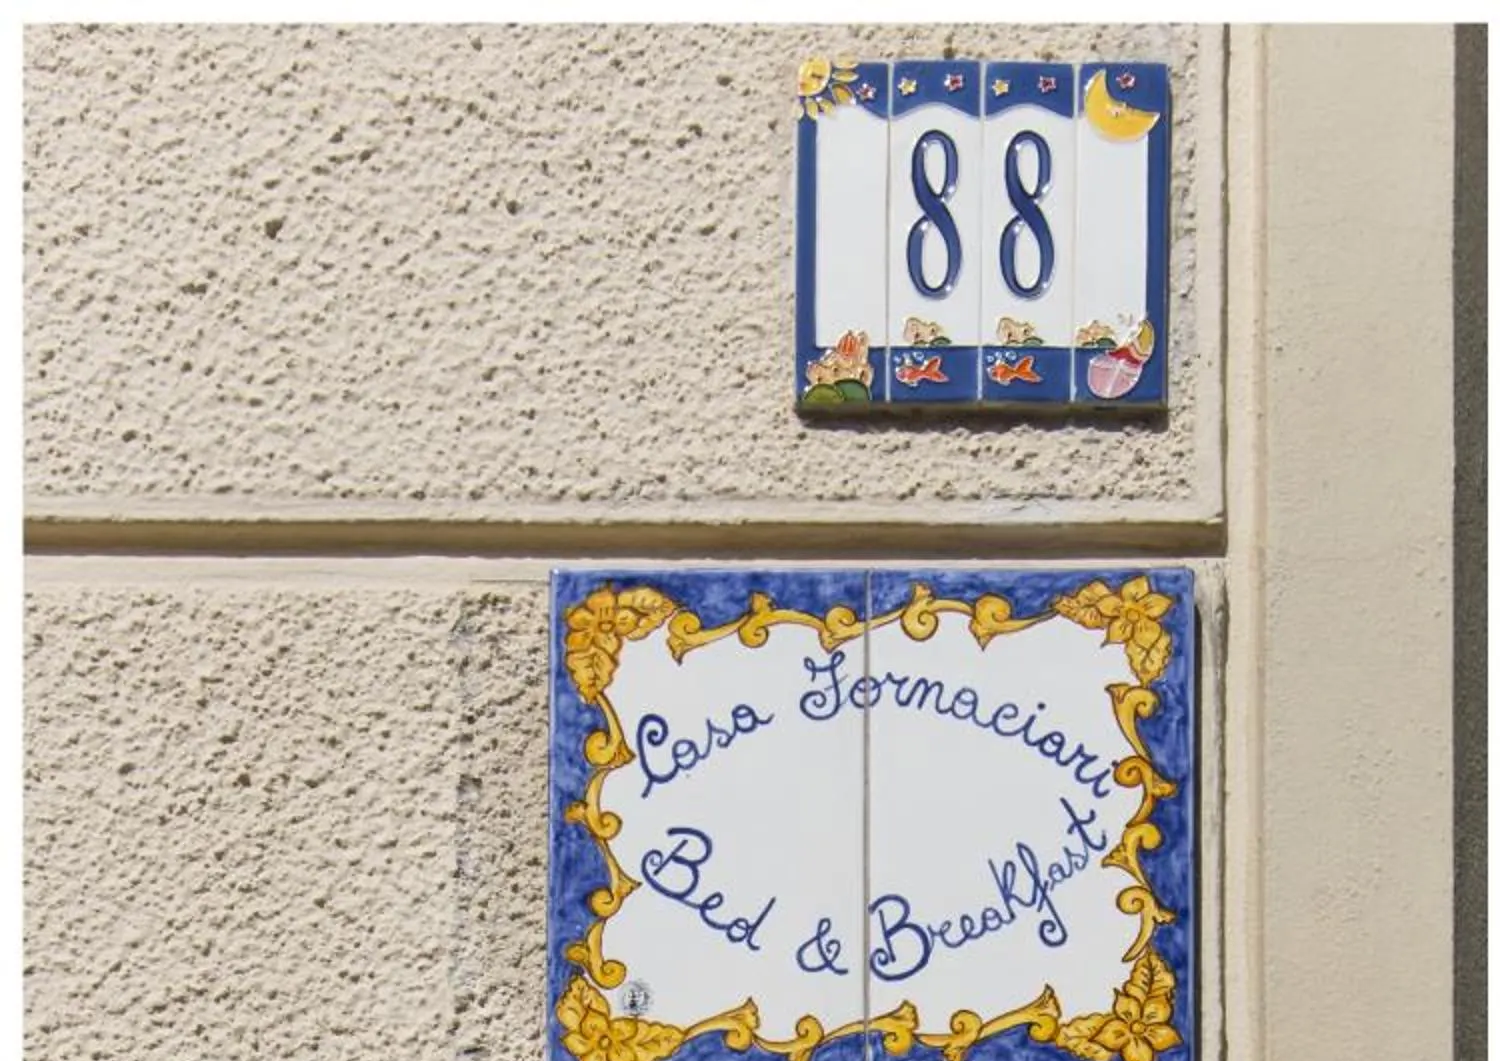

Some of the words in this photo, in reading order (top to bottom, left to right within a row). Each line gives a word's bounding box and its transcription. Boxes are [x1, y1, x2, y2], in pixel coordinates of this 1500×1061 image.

[906, 129, 1056, 299] 88
[635, 704, 774, 798] Casa
[800, 651, 1112, 797] Fornaciari
[641, 828, 776, 951] Bed
[796, 918, 849, 975] &
[870, 798, 1107, 981] Breakfast
